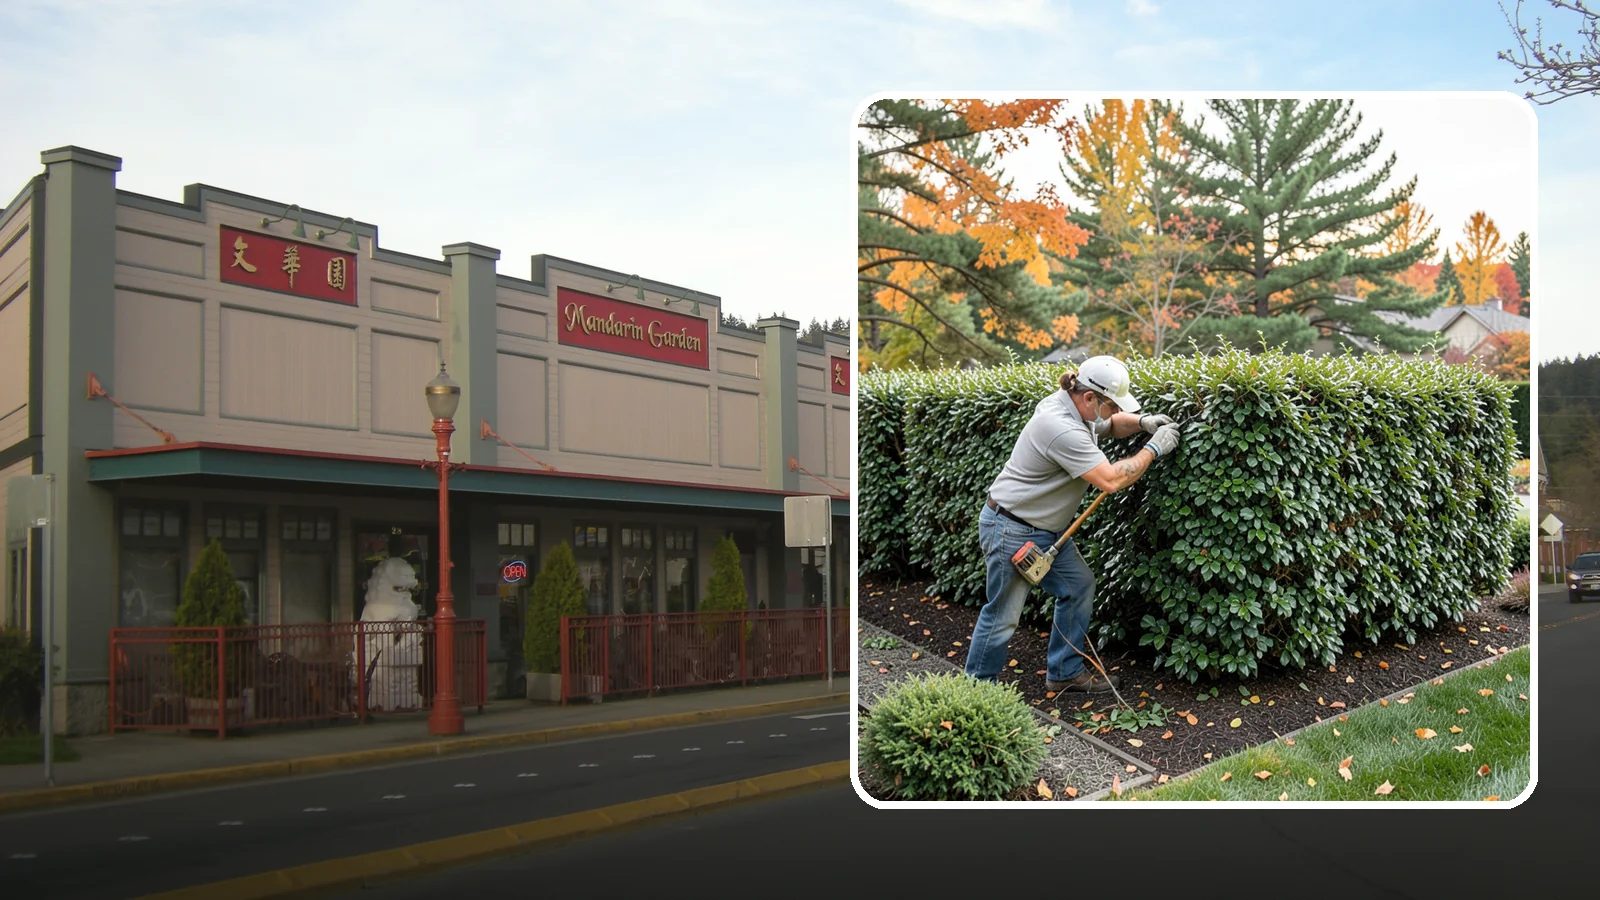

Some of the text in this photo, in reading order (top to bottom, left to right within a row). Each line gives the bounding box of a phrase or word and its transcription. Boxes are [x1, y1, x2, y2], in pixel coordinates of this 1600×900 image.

[231, 236, 346, 291] 文華園
[564, 302, 702, 352] Mandarin Garden
[503, 565, 527, 578] OPEN
